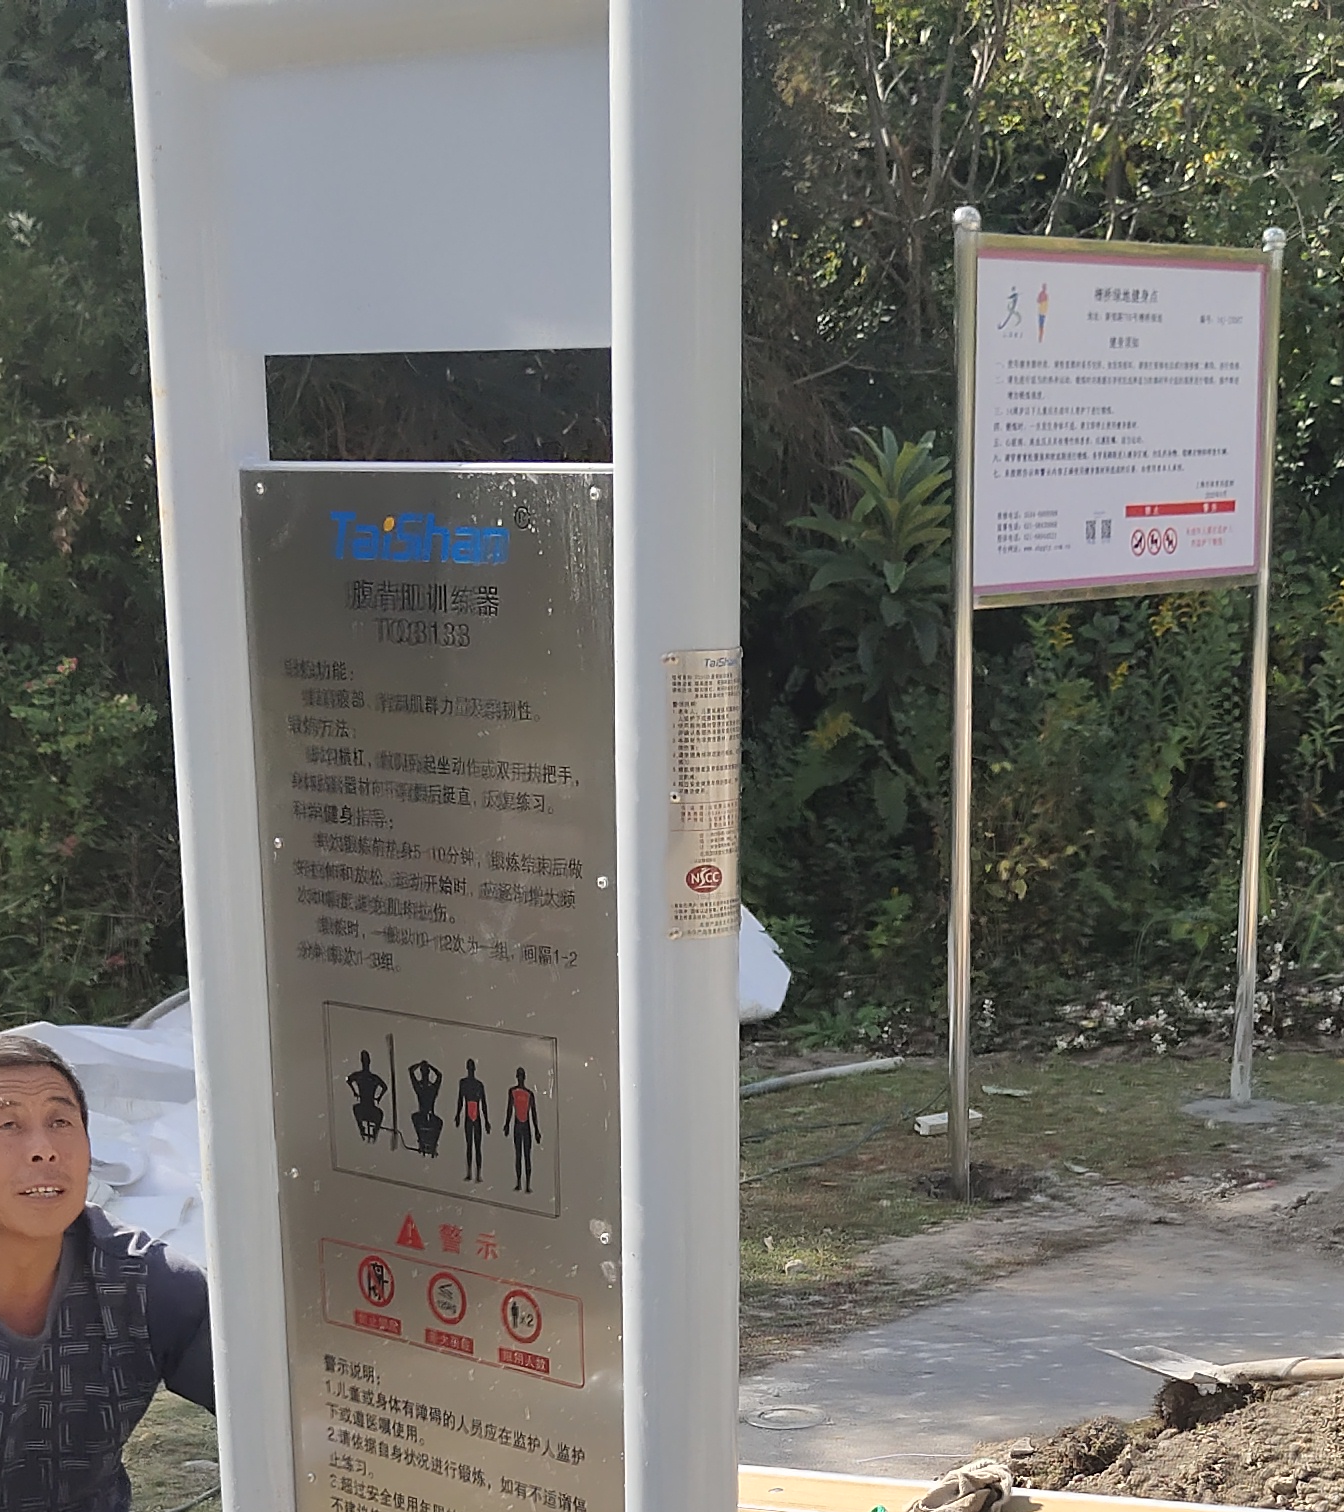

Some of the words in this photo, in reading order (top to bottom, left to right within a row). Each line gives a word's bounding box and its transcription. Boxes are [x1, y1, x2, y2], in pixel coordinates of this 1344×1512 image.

[330, 511, 510, 565] TaiShan
[346, 580, 500, 617] 腹背肌训练器
[691, 867, 720, 887] NSCC
[439, 1223, 499, 1261] 警示
[325, 1380, 586, 1467] 1.儿童或身体有障碍的人员应在监护人监护
[325, 1402, 425, 1447] 下或遵医嘱使用。
